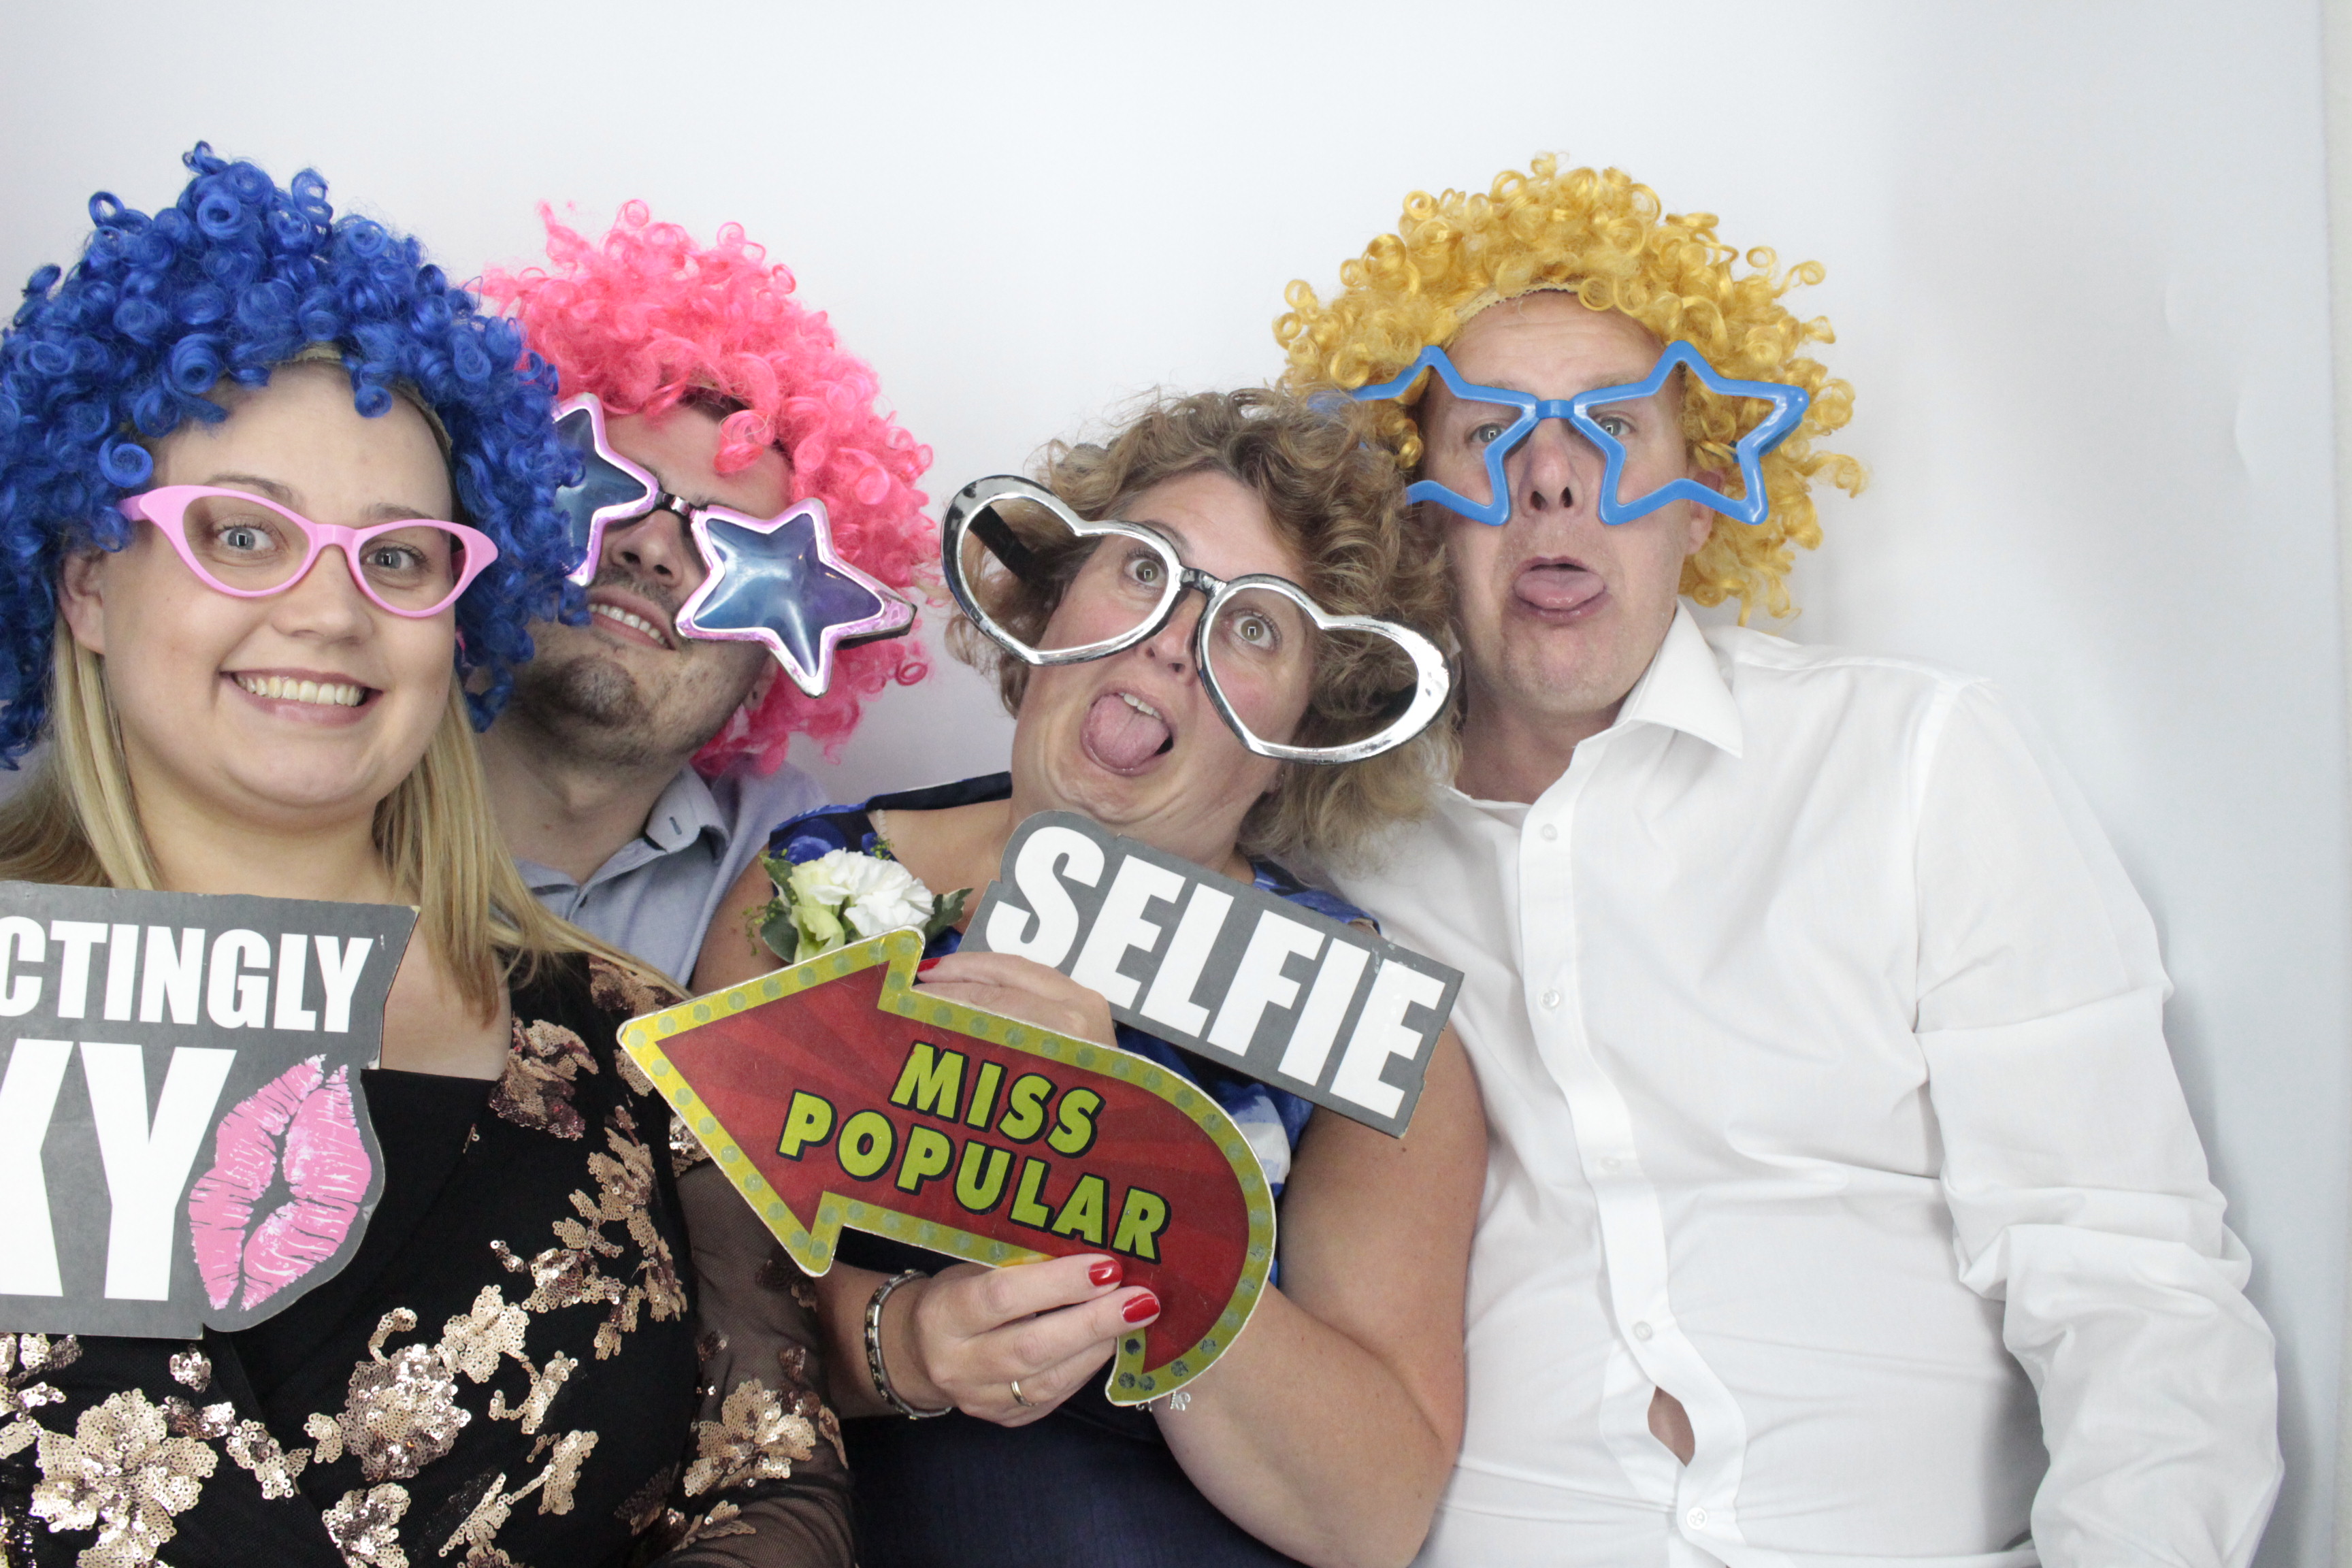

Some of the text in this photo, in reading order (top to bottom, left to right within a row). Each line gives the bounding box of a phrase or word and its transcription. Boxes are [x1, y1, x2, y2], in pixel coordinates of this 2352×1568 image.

[985, 826, 1446, 1120] SELFIE
[775, 1090, 1171, 1264] POPULAR
[889, 1040, 1105, 1158] MISS
